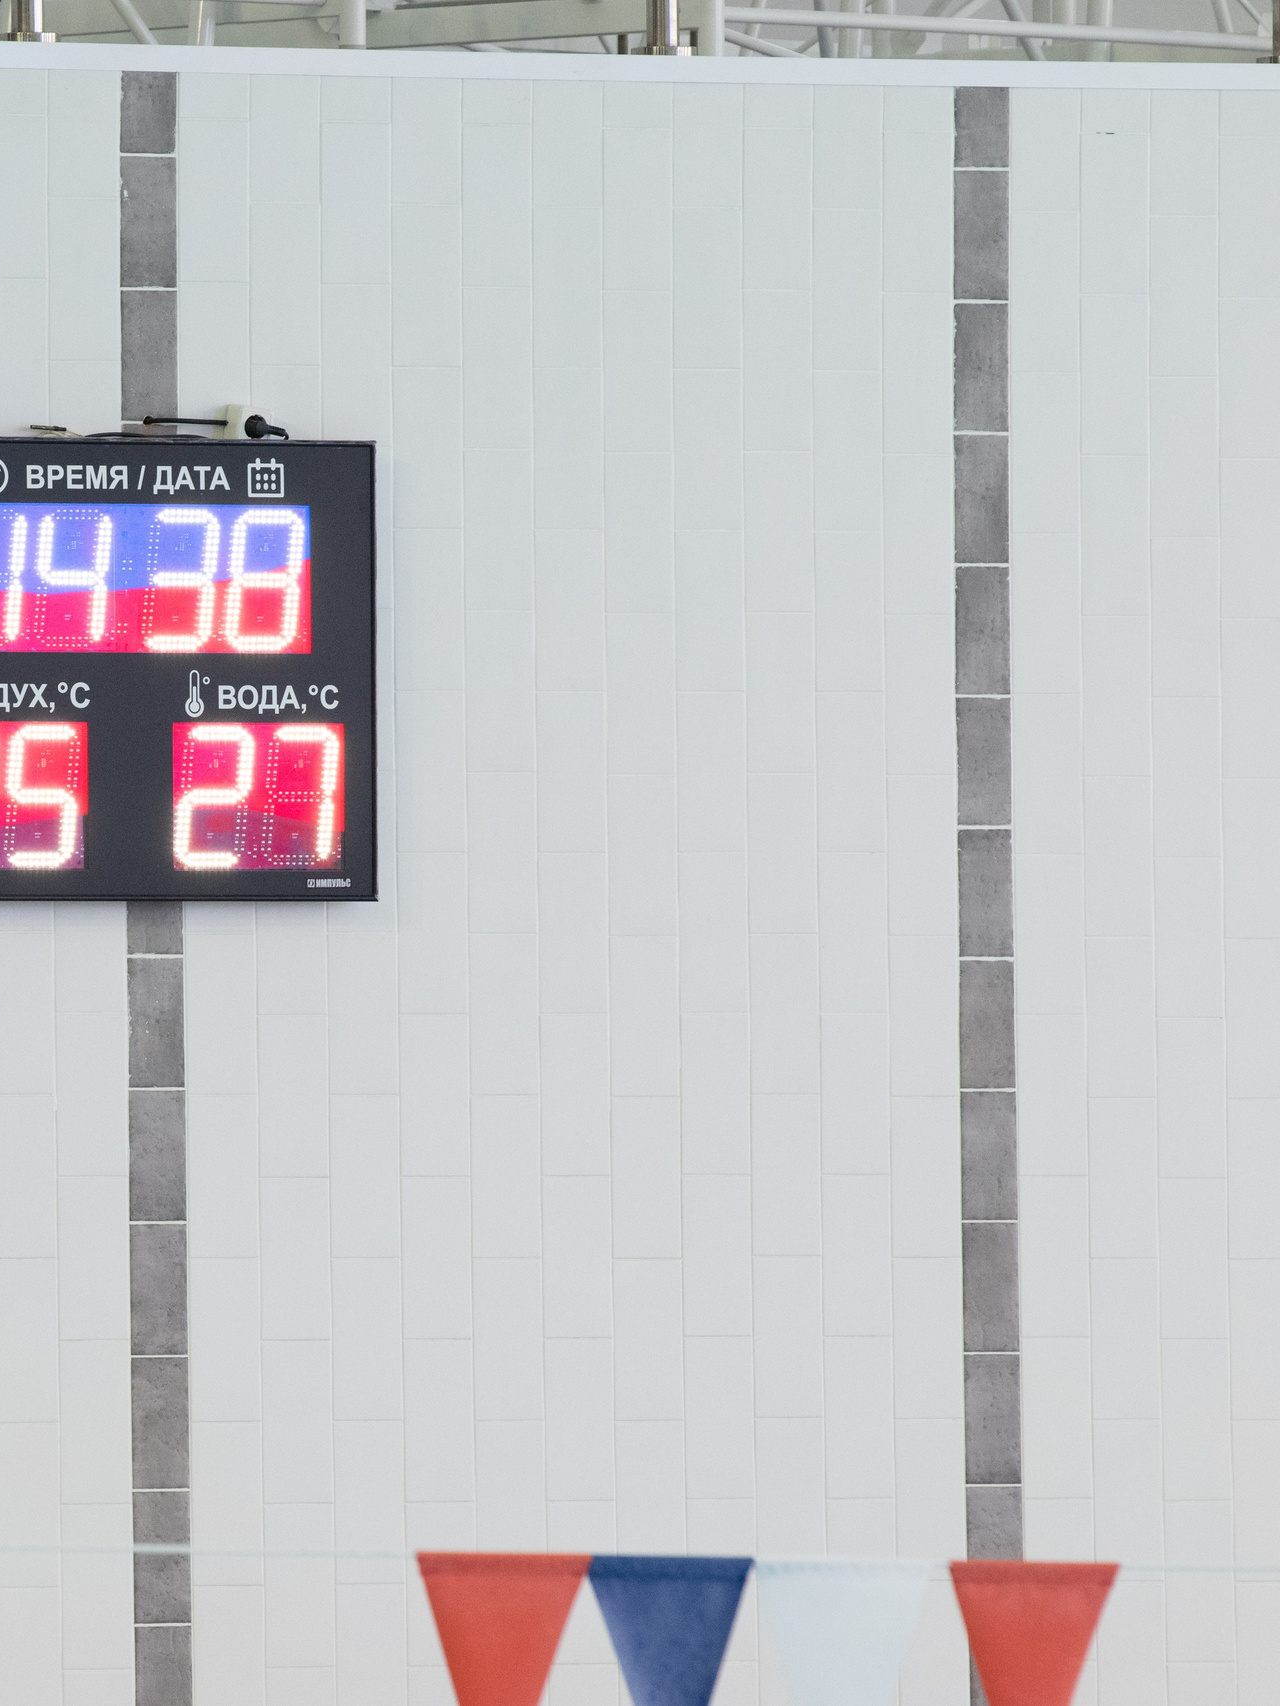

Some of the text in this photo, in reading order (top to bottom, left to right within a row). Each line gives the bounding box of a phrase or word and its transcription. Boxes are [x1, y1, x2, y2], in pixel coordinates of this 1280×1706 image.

[26, 464, 231, 495] ВРЕМЯ / ДАТА
[173, 724, 340, 869] 27
[315, 878, 352, 888] ИМПУЛЬС
